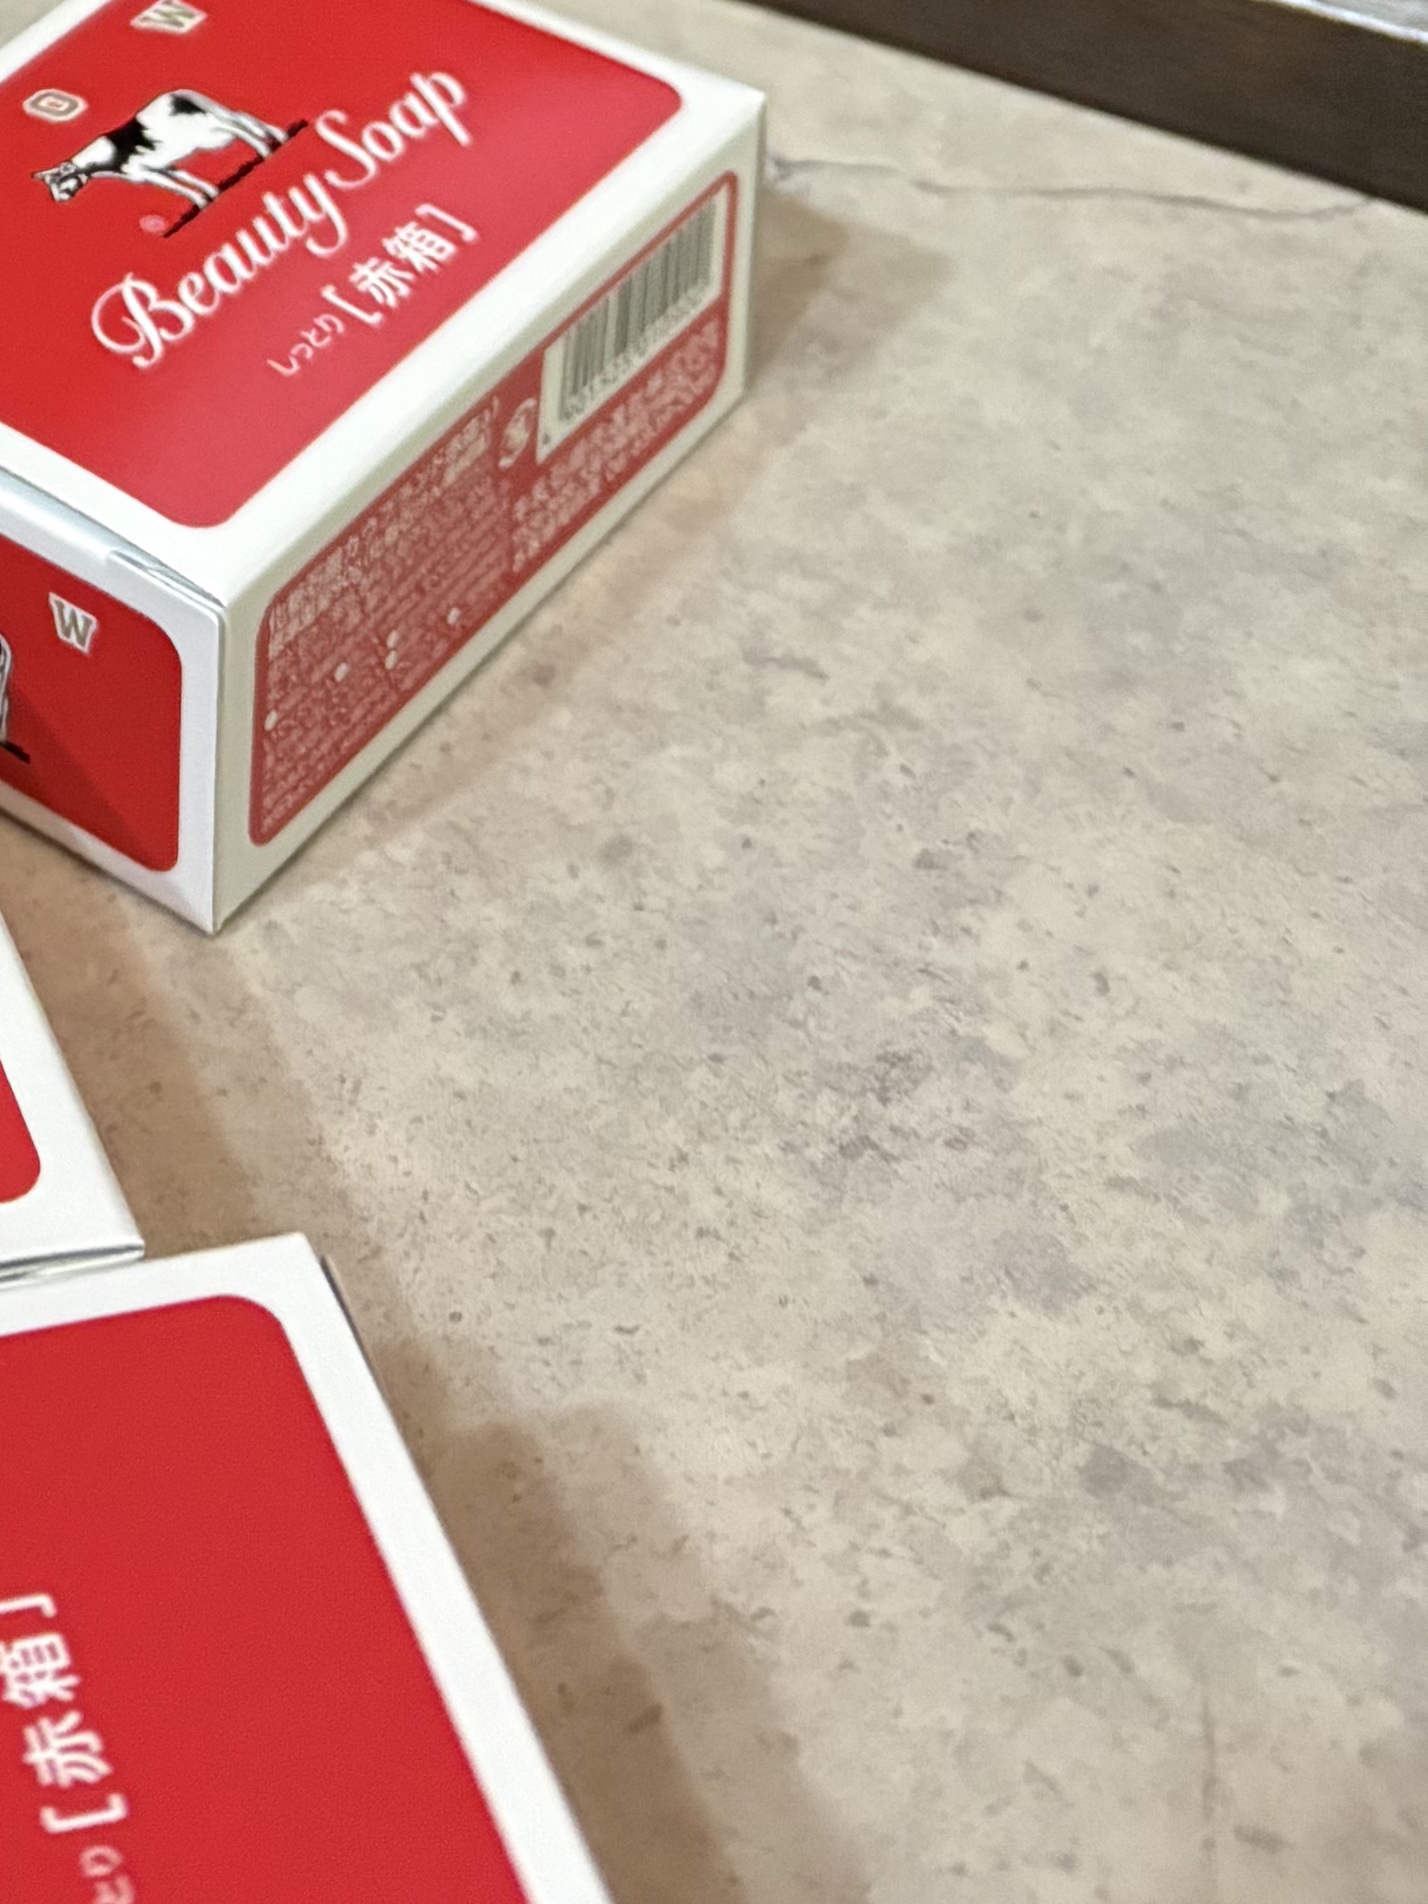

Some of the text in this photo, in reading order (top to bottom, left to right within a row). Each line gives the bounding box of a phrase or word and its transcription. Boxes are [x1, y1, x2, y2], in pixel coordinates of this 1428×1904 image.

[22, 86, 88, 122] O
[90, 70, 474, 368] Beauty Soap
[266, 202, 479, 378] しっとり [赤箱]
[48, 591, 97, 654] W
